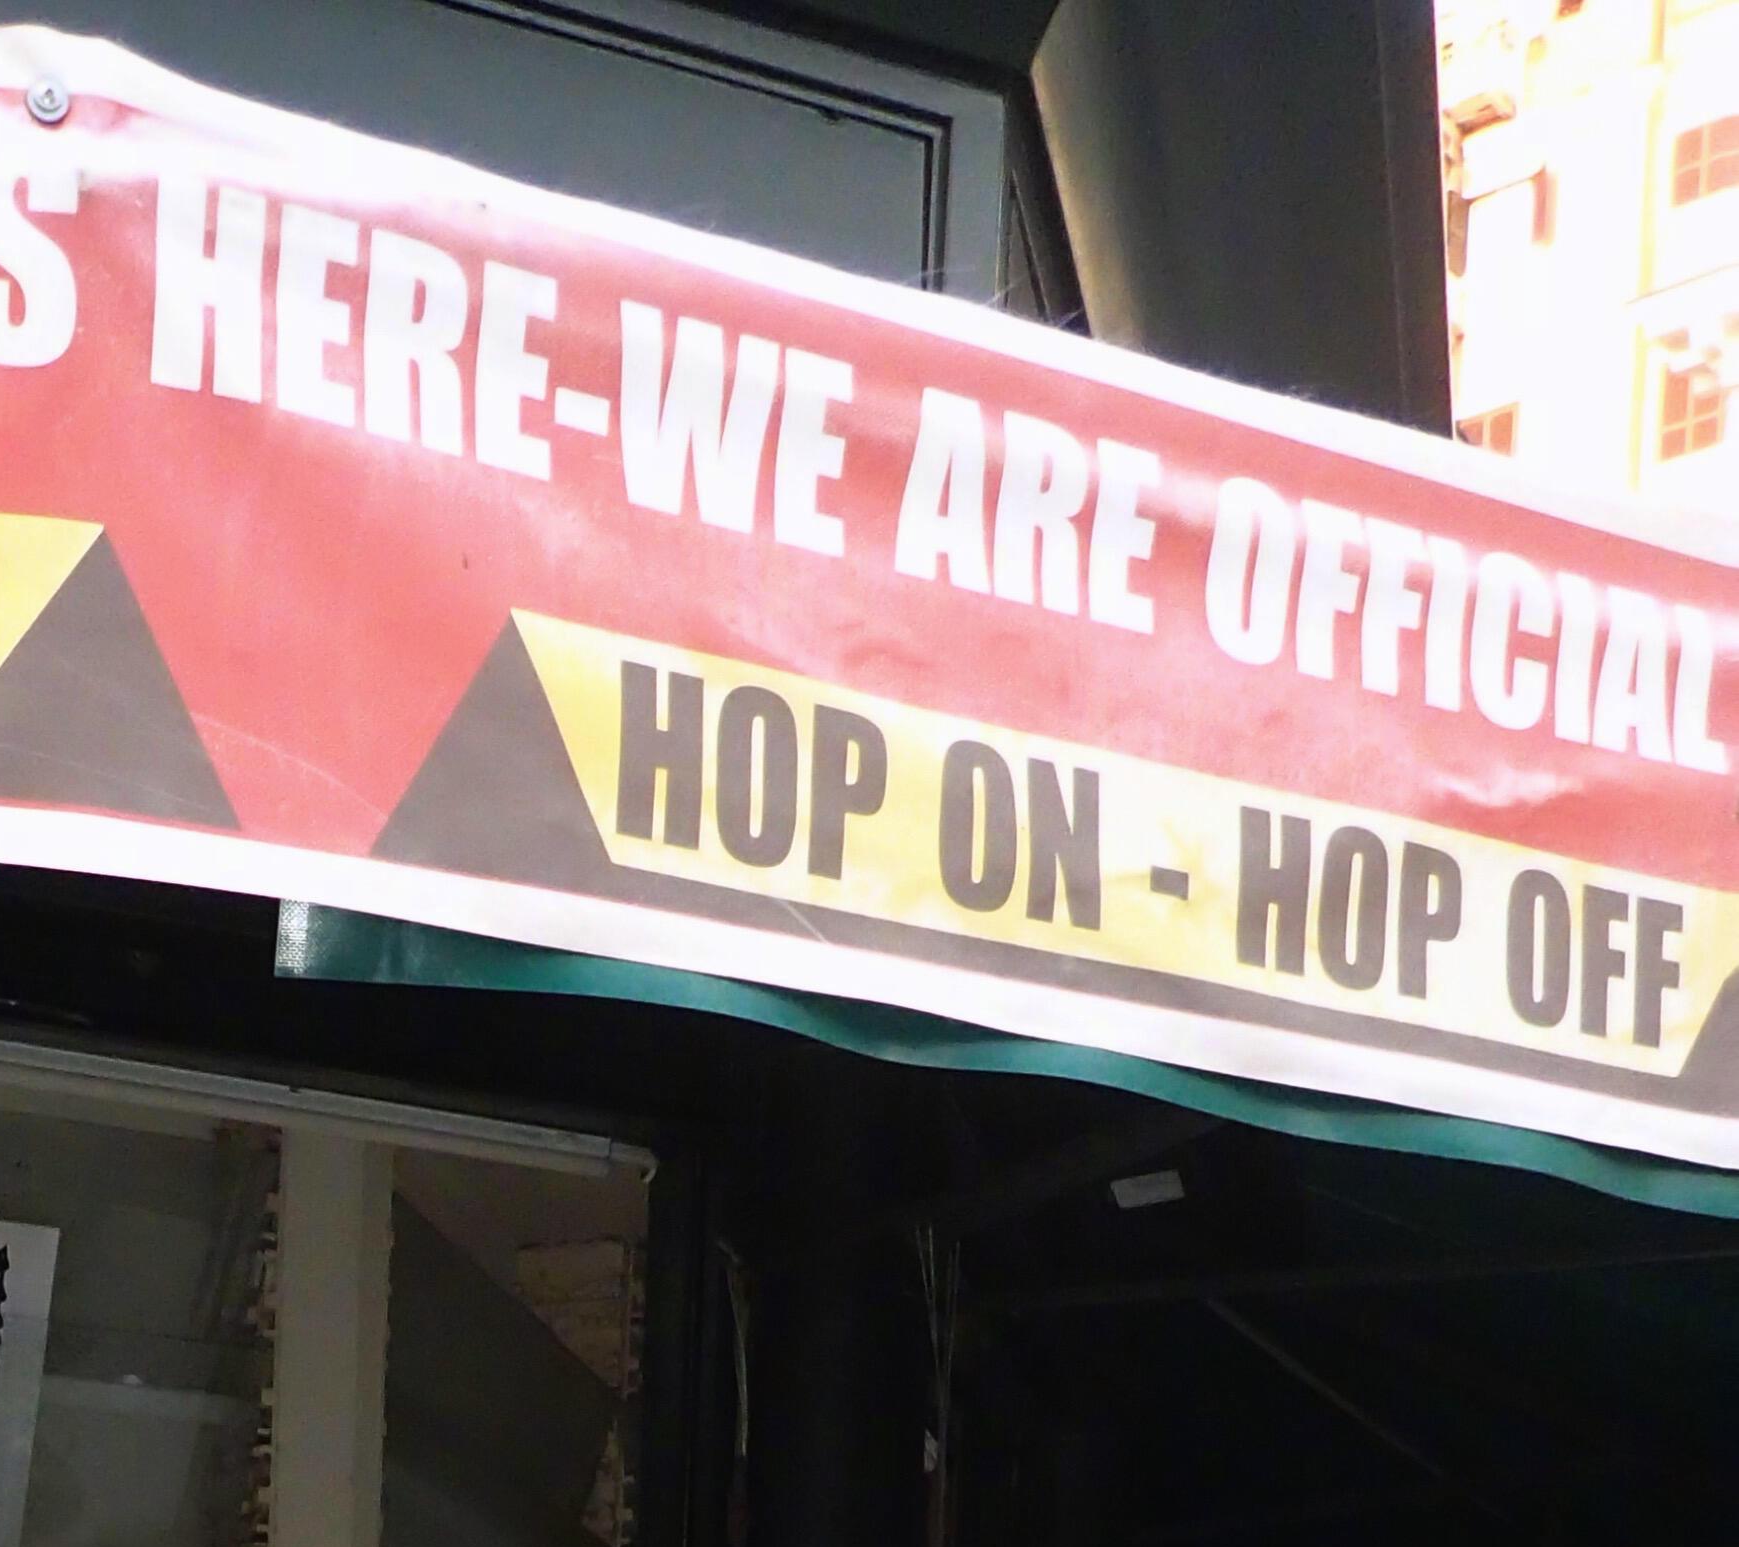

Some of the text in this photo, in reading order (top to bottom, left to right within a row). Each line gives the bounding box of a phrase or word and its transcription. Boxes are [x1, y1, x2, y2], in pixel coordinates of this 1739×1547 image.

[150, 172, 852, 556] HERE-WE
[894, 386, 1161, 634] ARE
[1204, 473, 1730, 774] OFFICIAL
[613, 660, 888, 882] HOP
[937, 738, 1103, 930] ON
[1234, 804, 1463, 998] HOP
[1504, 867, 1685, 1048] OFF
